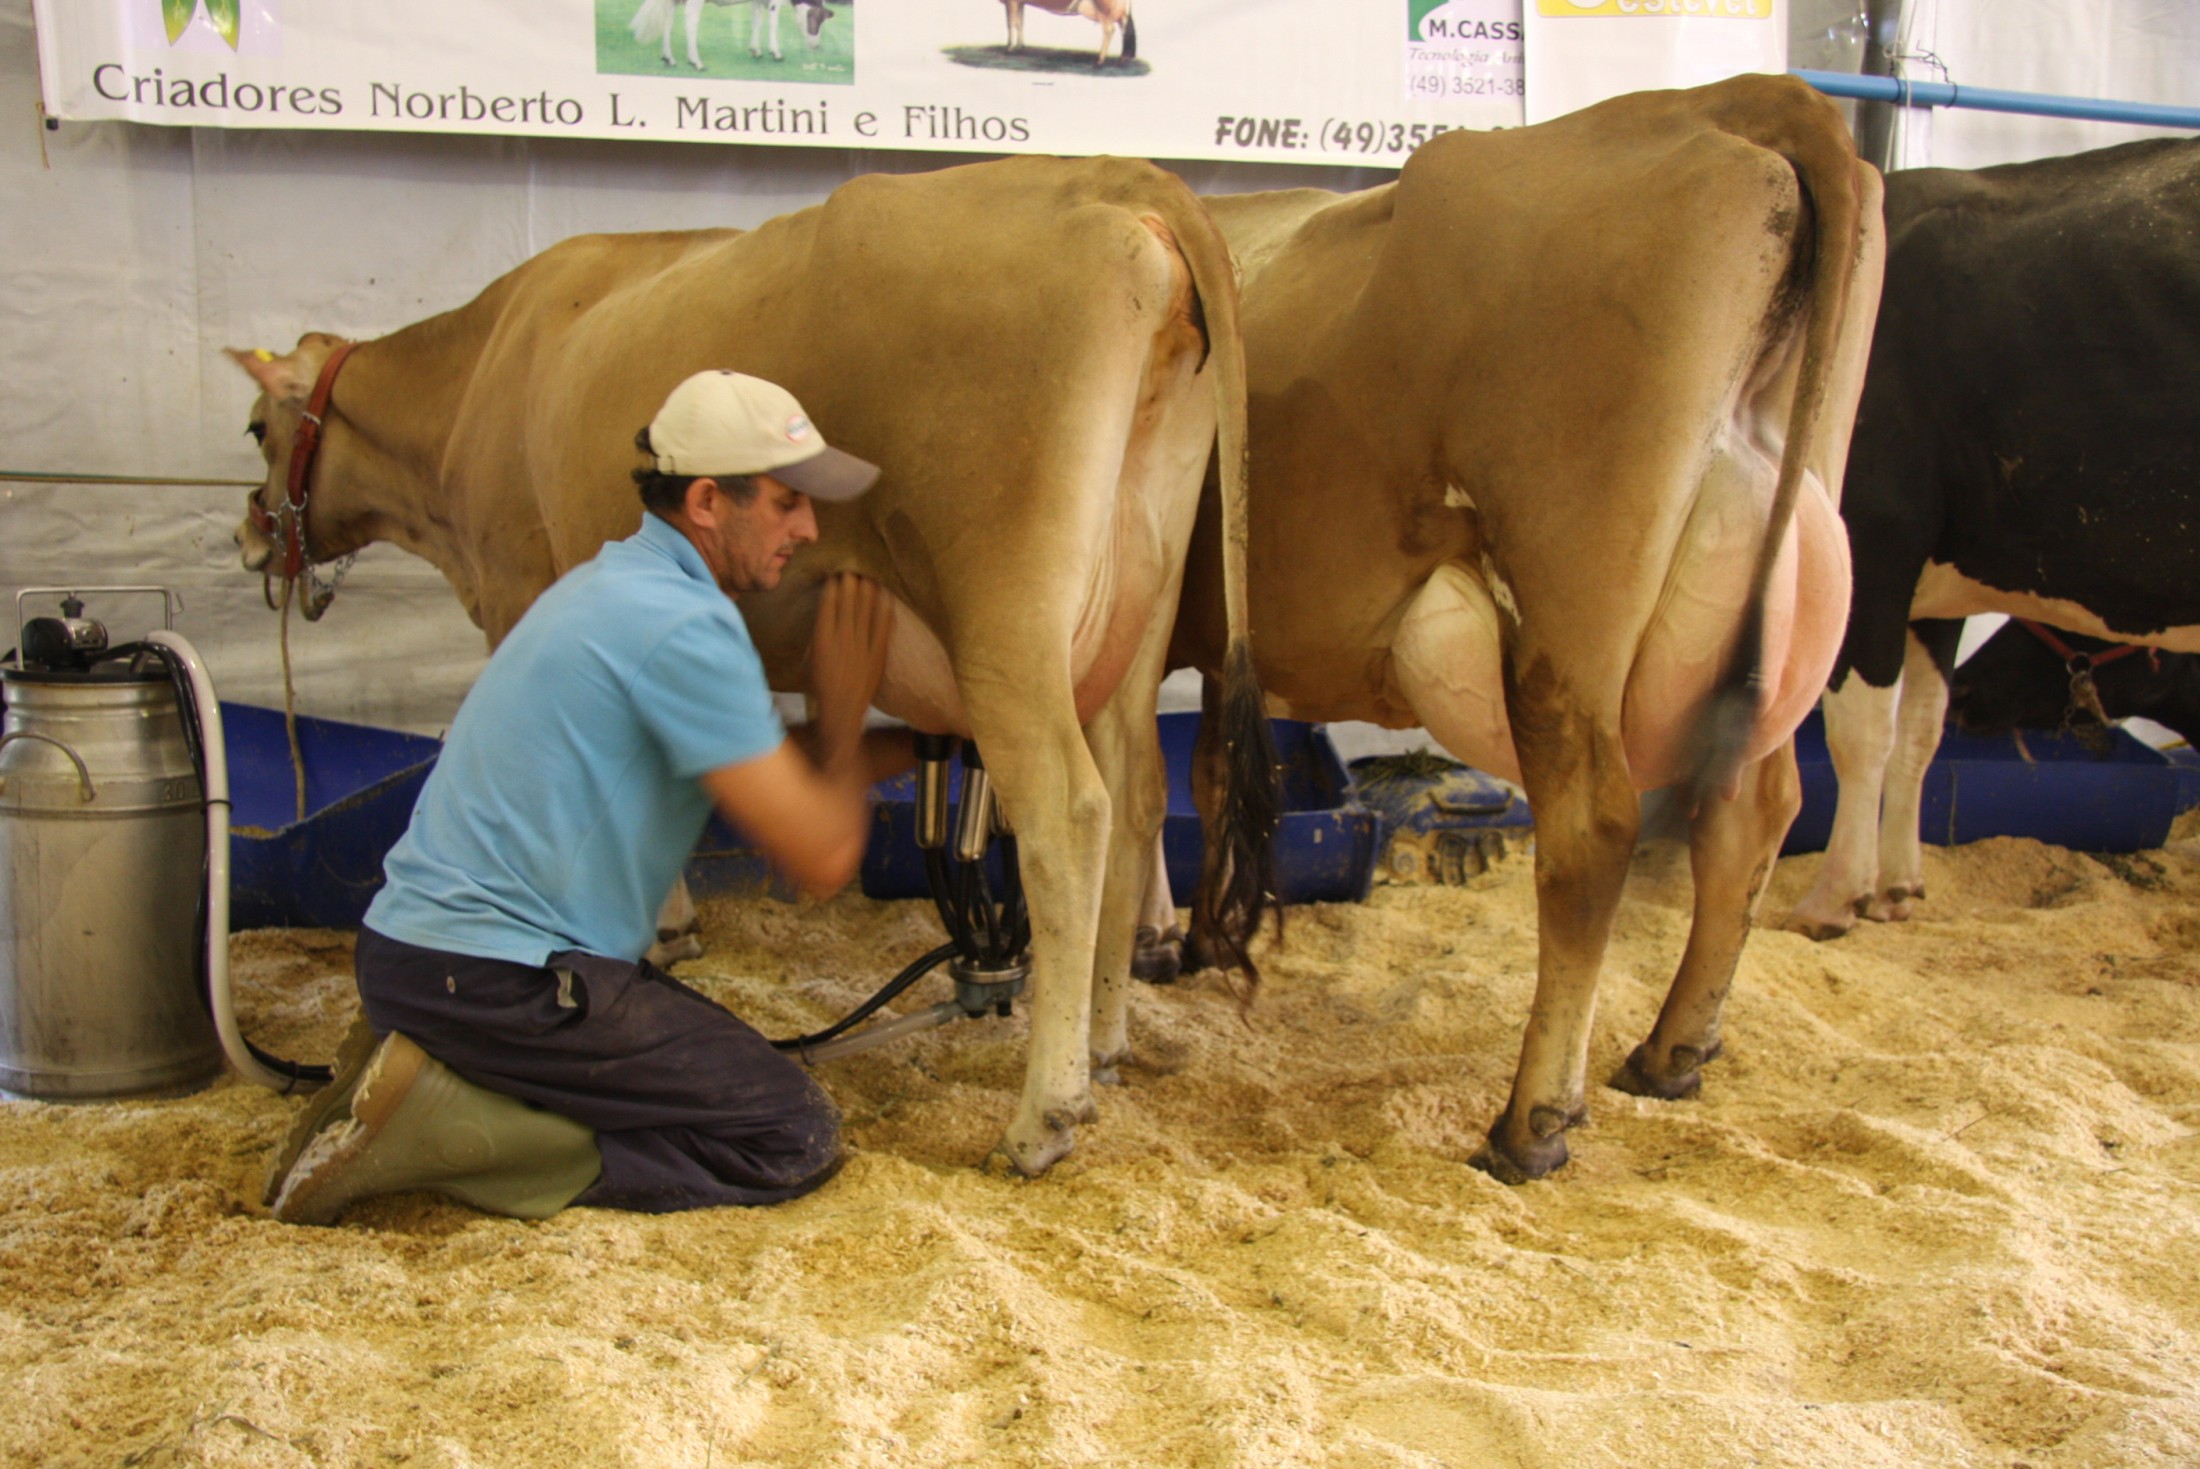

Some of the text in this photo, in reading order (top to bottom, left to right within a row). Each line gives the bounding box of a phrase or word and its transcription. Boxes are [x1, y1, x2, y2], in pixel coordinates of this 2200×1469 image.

[1429, 19, 1524, 41] M.CASS
[1410, 47, 1490, 68] Tecnologia
[1410, 75, 1446, 97] (49)
[93, 63, 1030, 142] Criadores Norberto L. Martini e Filhos
[1214, 117, 1309, 149] FONE:
